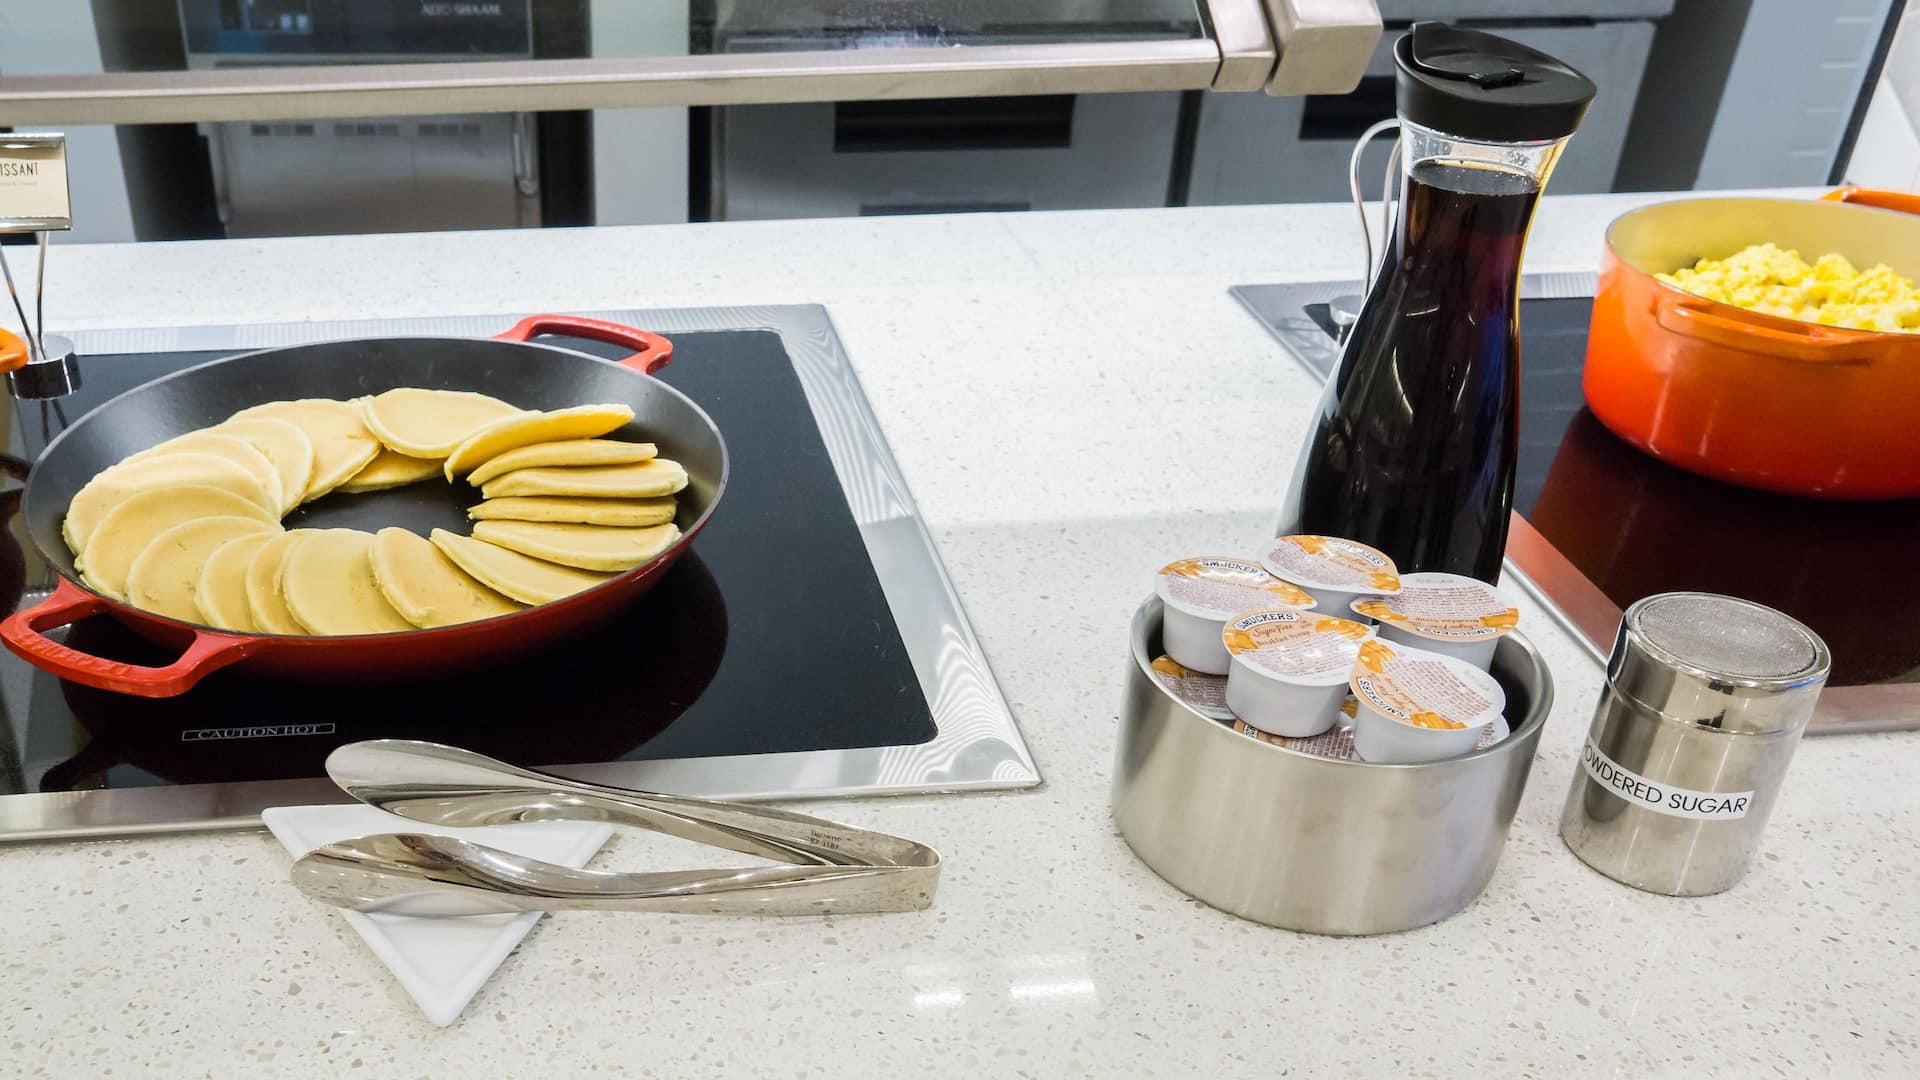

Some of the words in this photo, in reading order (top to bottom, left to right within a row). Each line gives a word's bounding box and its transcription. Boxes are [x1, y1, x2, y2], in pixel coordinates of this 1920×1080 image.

[198, 727, 278, 740] CAUTION
[284, 724, 321, 736] HOT
[1668, 793, 1747, 814] SUGAR
